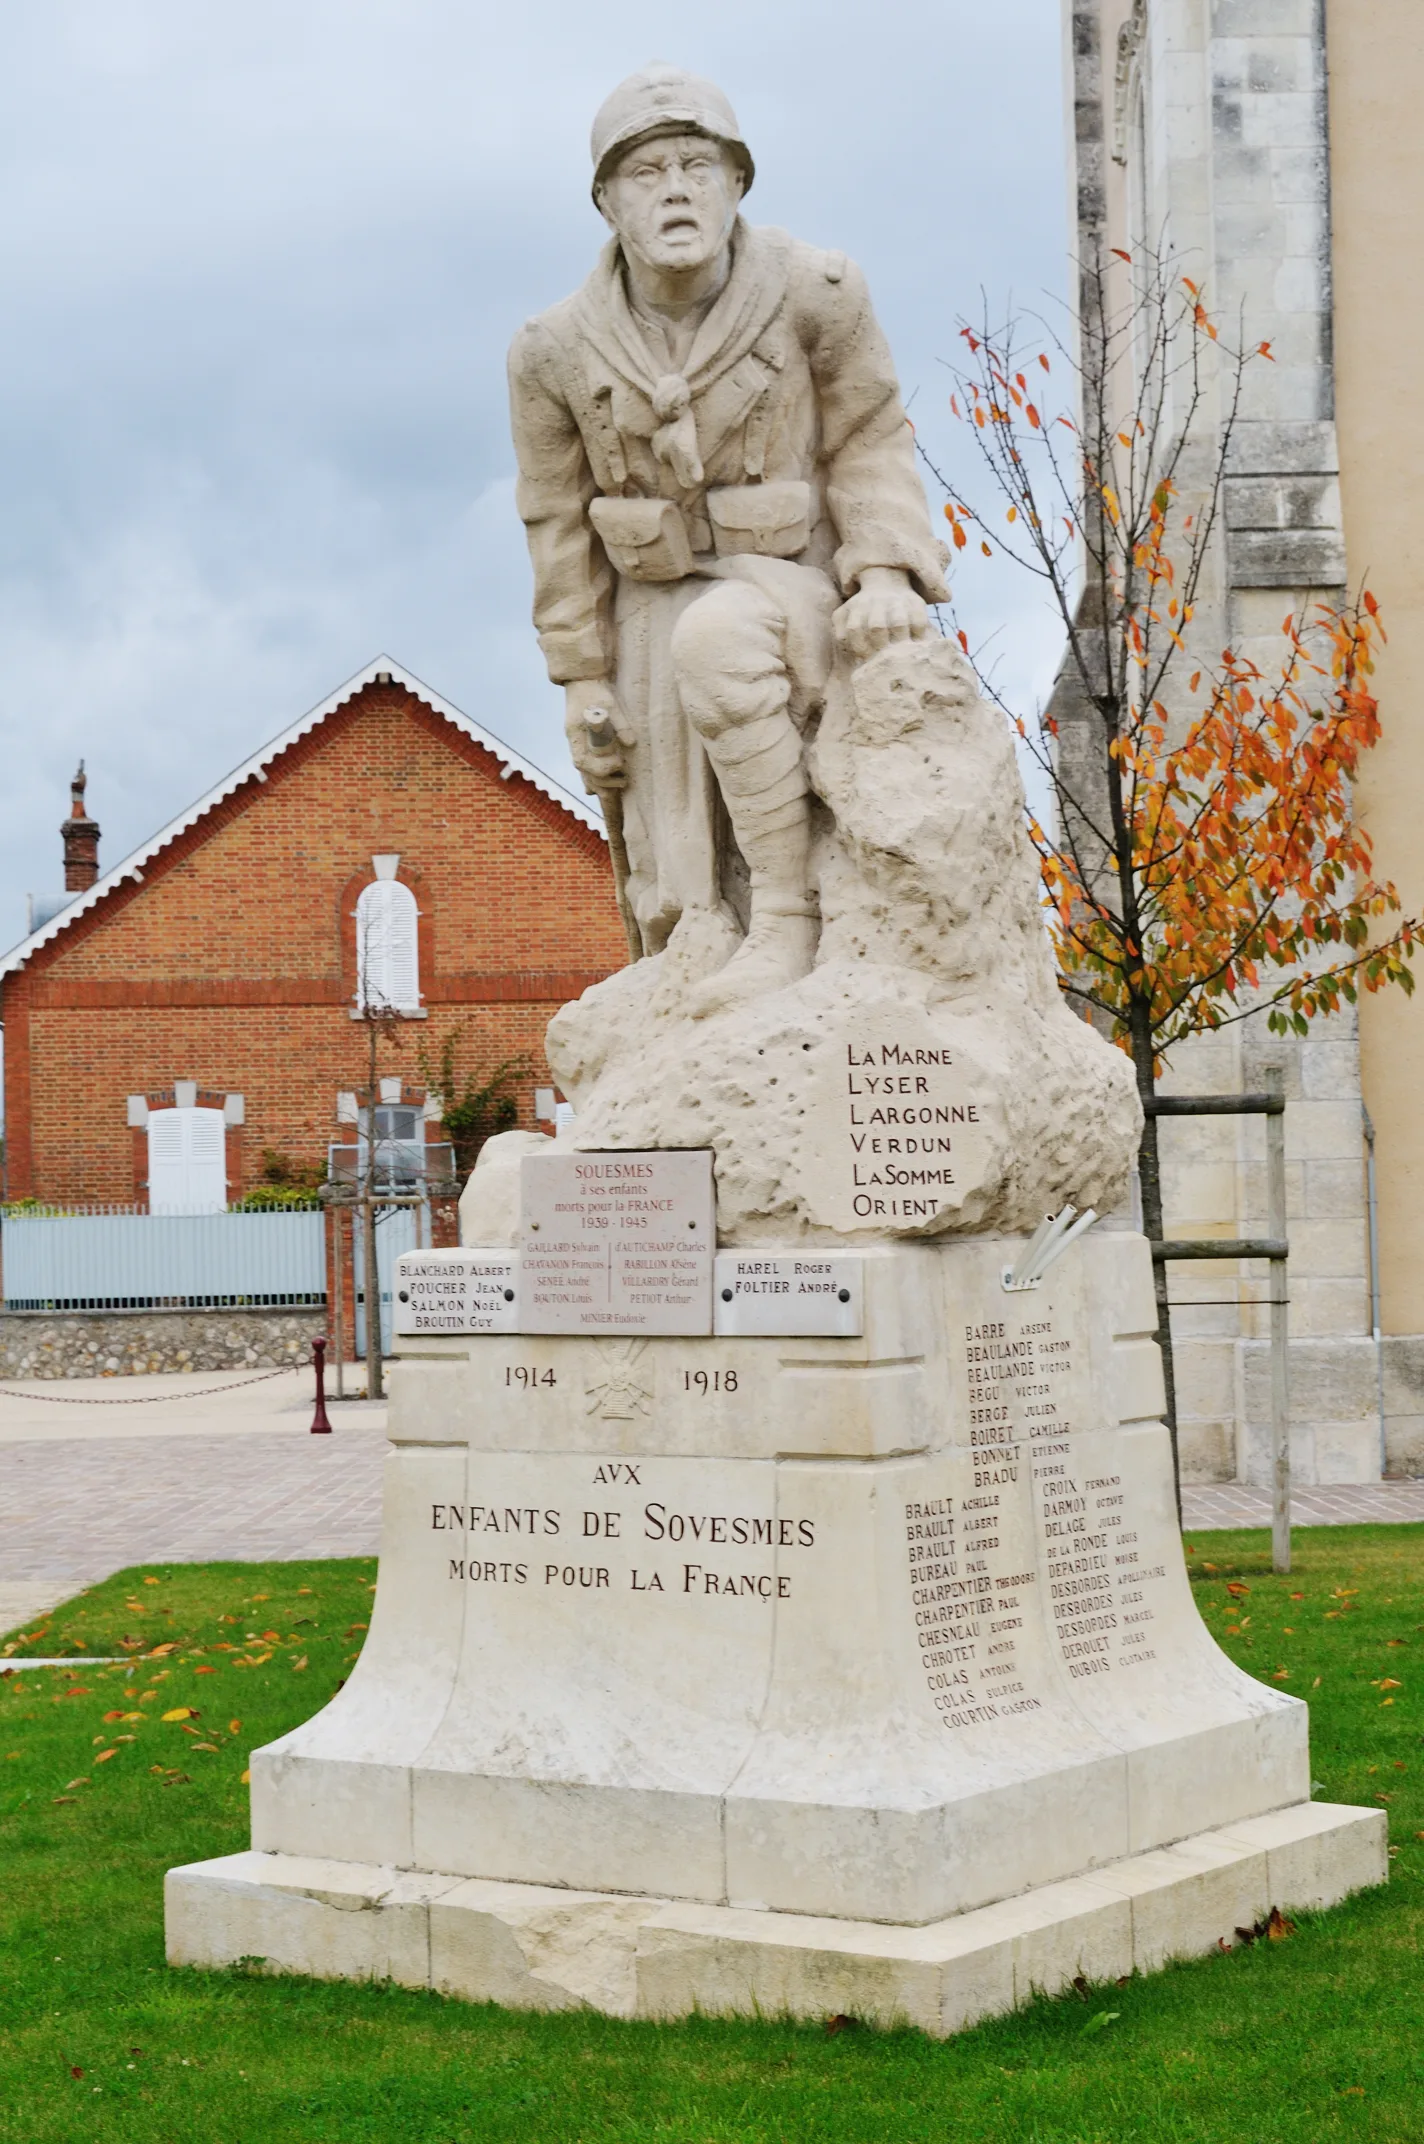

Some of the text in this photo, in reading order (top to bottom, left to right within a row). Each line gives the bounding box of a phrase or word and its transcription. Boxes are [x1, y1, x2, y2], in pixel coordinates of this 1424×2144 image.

[882, 1044, 953, 1066] MARNE
[849, 1073, 930, 1095] LYSER
[850, 1104, 980, 1125] LARGONNE
[849, 1133, 951, 1154] VERDUN
[575, 1164, 654, 1178] SOUESMES
[589, 1186, 605, 1195] ses
[609, 1182, 648, 1195] enfants
[555, 1199, 674, 1214] morts pour la FRANCE
[853, 1194, 938, 1217] ORIENT
[581, 1217, 608, 1228] 1939
[620, 1217, 648, 1228] 1945
[527, 1243, 569, 1252] GAILLARD
[676, 1242, 707, 1252] Charles
[400, 1265, 511, 1276] BLANCHARD ALBERT
[624, 1260, 667, 1269] RABILLON
[737, 1263, 832, 1274] HAREL ROGER
[410, 1282, 503, 1294] FOUCHER JEAN
[533, 1293, 593, 1303] BOUTON Louis
[630, 1293, 692, 1303] PETIOT Arthur
[411, 1300, 464, 1311] SALMON
[415, 1316, 493, 1327] BROUTIN GUY
[965, 1322, 1052, 1341] BARRE ARSENE
[966, 1341, 1071, 1363] BEAULANDE GASTON
[505, 1366, 739, 1396] 1914 1918
[967, 1361, 1072, 1383] BEAULANDE VICTOR
[1015, 1384, 1051, 1398] VICTOR
[970, 1403, 1057, 1424] BERGE JULIEN
[970, 1422, 1071, 1446] BOIRET CAMILLE
[972, 1443, 1071, 1466] BONNET ETIENNE
[592, 1464, 642, 1486] AVX
[974, 1465, 1065, 1487] BRADU PIERRE
[1042, 1476, 1121, 1497] CROIX FERNAND
[905, 1495, 1000, 1519] BRAULT ACHILLE
[1044, 1495, 1124, 1518] DARMOY OCTAVE
[431, 1502, 815, 1548] ENFANTS DE SOVESMES
[906, 1516, 999, 1541] BRAULT ALBERT
[1045, 1515, 1122, 1538] DELAGE JULES
[908, 1537, 1000, 1562] BRAULT ALFRED
[1047, 1532, 1138, 1558] DE LA RONDE LOUIS
[449, 1559, 528, 1585] MORTS
[545, 1564, 610, 1588] POUR
[631, 1569, 665, 1592] LA
[910, 1560, 988, 1584] BUREAU PAUL
[1048, 1554, 1108, 1579] DEPARDIEU
[912, 1576, 992, 1606] CHARPENTIER
[1050, 1566, 1166, 1599] DESBORDES APOLLINAIRE
[915, 1597, 1020, 1627] CHARPENTIER PAUL
[1053, 1592, 1144, 1619] DESBORDES JULES
[918, 1618, 1023, 1648] CHESNEAU EUGENE
[1056, 1609, 1155, 1640] DESBORDES MARCEL
[922, 1641, 1016, 1669] CHROTET ANDRE
[1062, 1632, 1146, 1660] DEROUET JULES
[1069, 1650, 1156, 1679] DUBOIS CLOTAIRE
[927, 1662, 1017, 1691] COLAS ANTOINE
[934, 1682, 1025, 1711] COLAS SULPICE
[942, 1698, 1043, 1729] COURTIN GASTON
